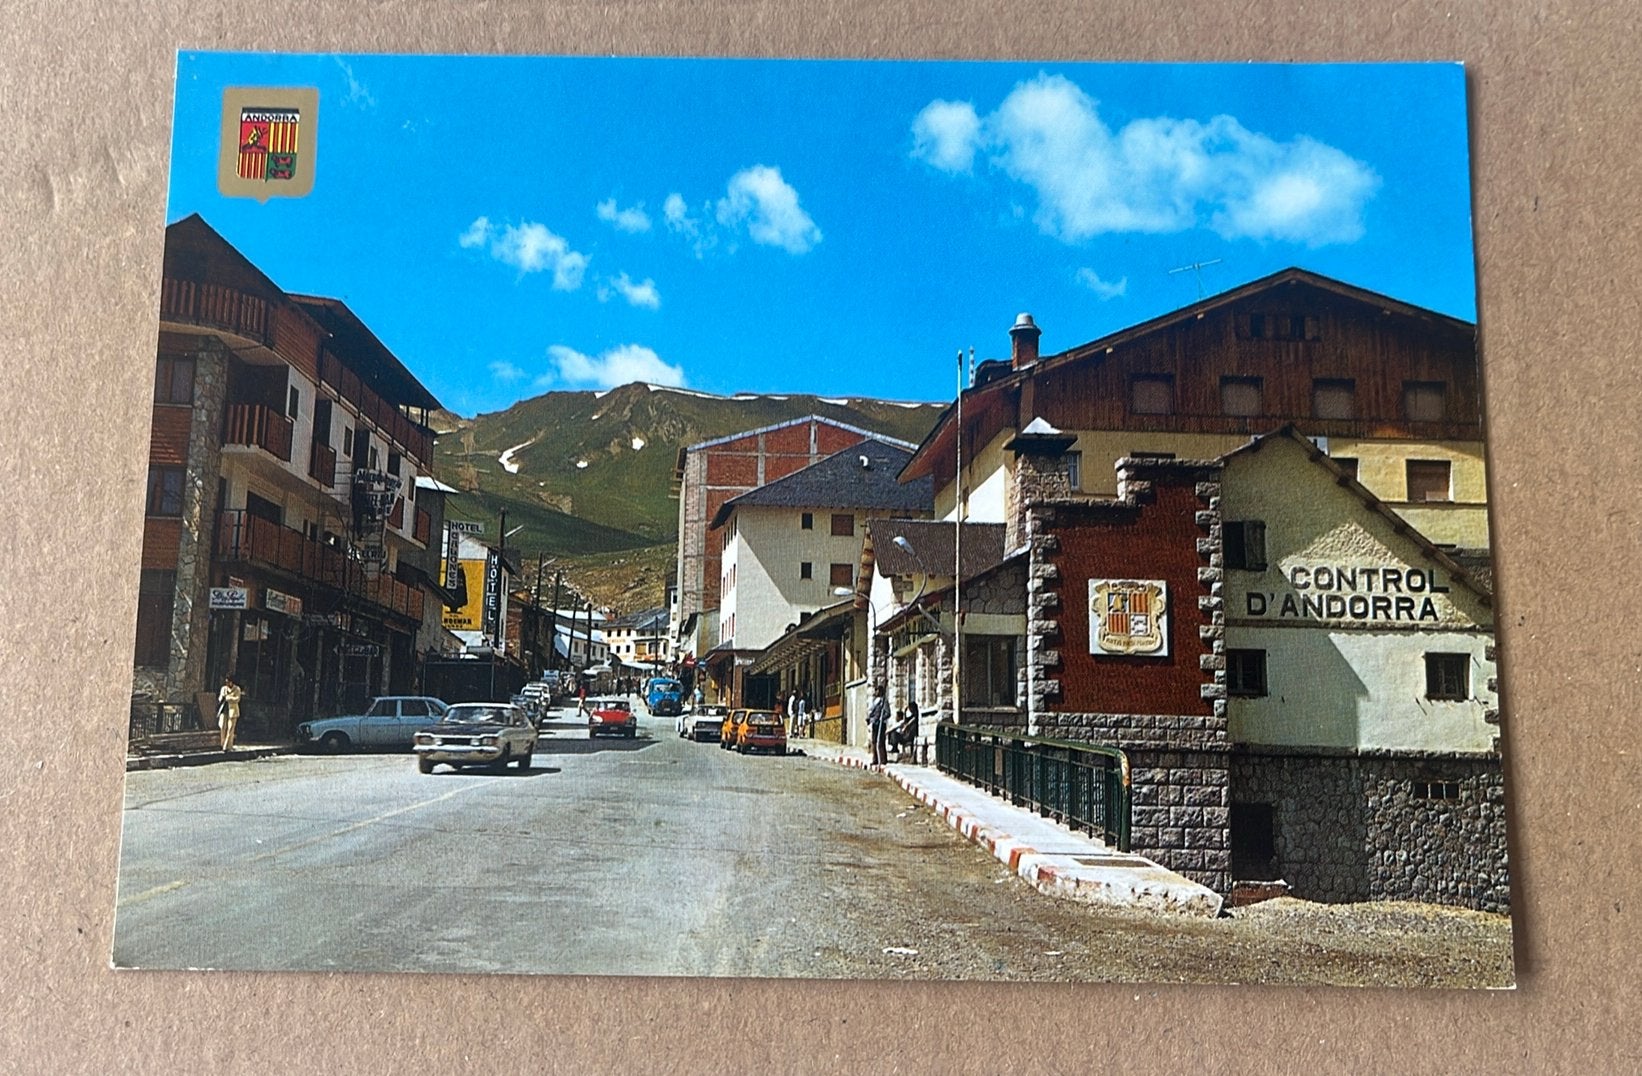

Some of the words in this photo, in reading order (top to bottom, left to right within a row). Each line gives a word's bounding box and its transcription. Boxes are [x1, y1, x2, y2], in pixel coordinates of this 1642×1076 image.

[245, 114, 298, 123] ANDORRA
[451, 522, 483, 532] HOTEL
[488, 555, 498, 621] HOTEL
[1289, 565, 1450, 593] CONTROL
[1246, 592, 1439, 622] D'ANDORRA
